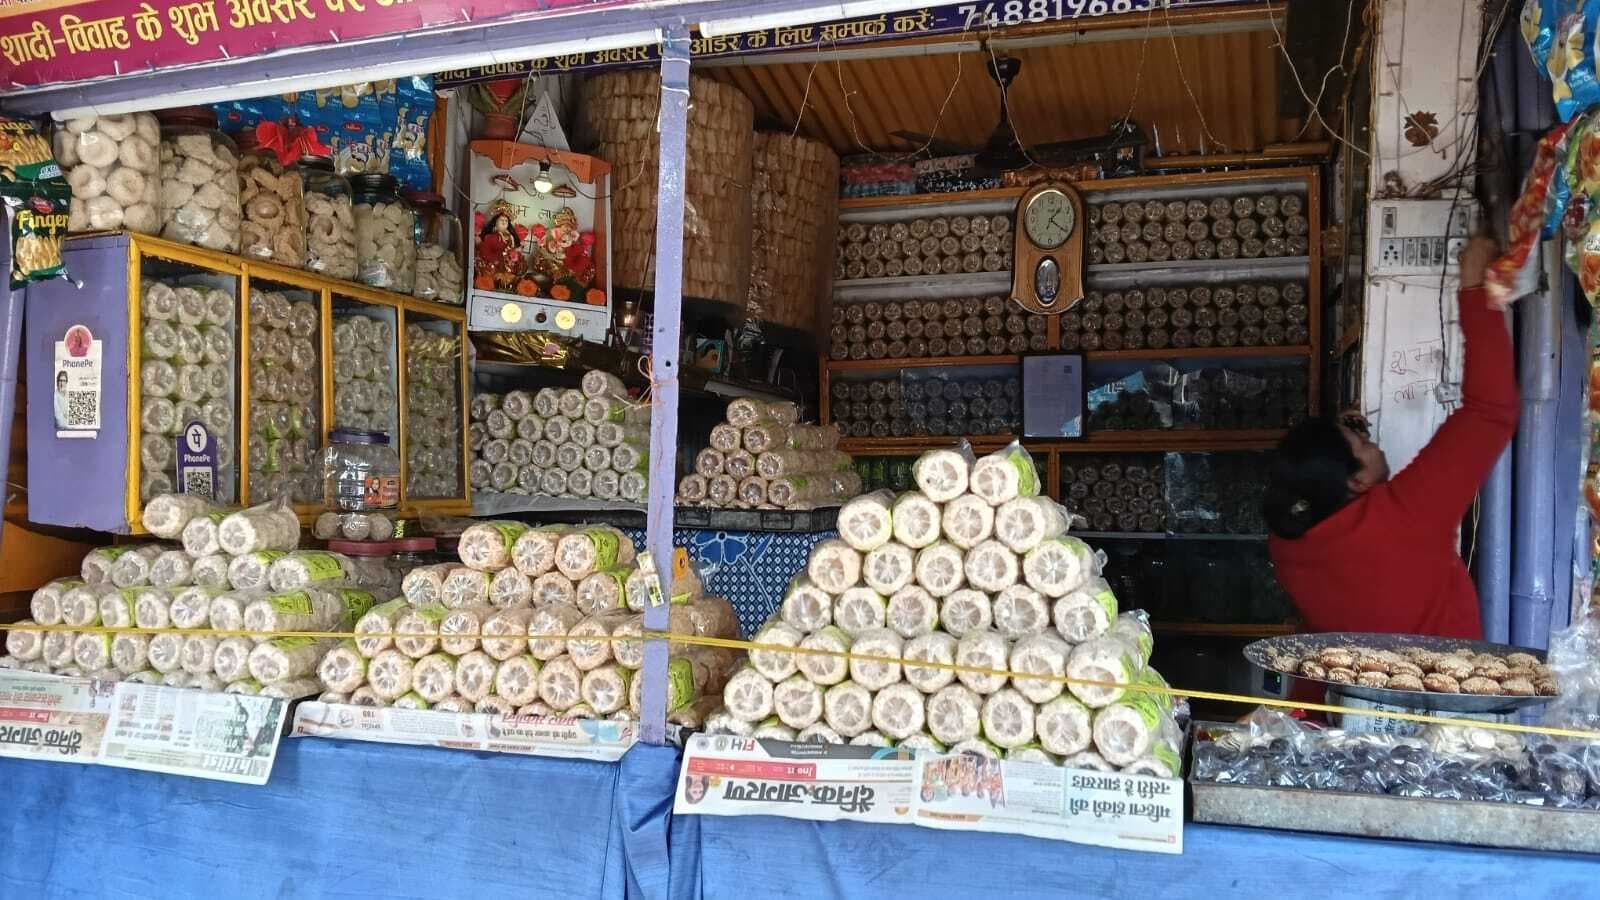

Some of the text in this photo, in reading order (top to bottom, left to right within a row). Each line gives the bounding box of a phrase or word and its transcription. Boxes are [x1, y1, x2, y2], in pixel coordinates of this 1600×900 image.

[1, 15, 131, 66] शादी-विवाह
[136, 3, 162, 41] के
[171, 3, 217, 42] शुभ
[62, 359, 93, 368] PhonePe
[183, 454, 211, 463] PhonePe
[723, 780, 808, 806] जागरण
[1071, 775, 1121, 794] झारखंड
[1137, 780, 1171, 798] नर्सरी
[811, 785, 875, 813] दैनिक
[1069, 797, 1171, 822] महिला हॉकी की
